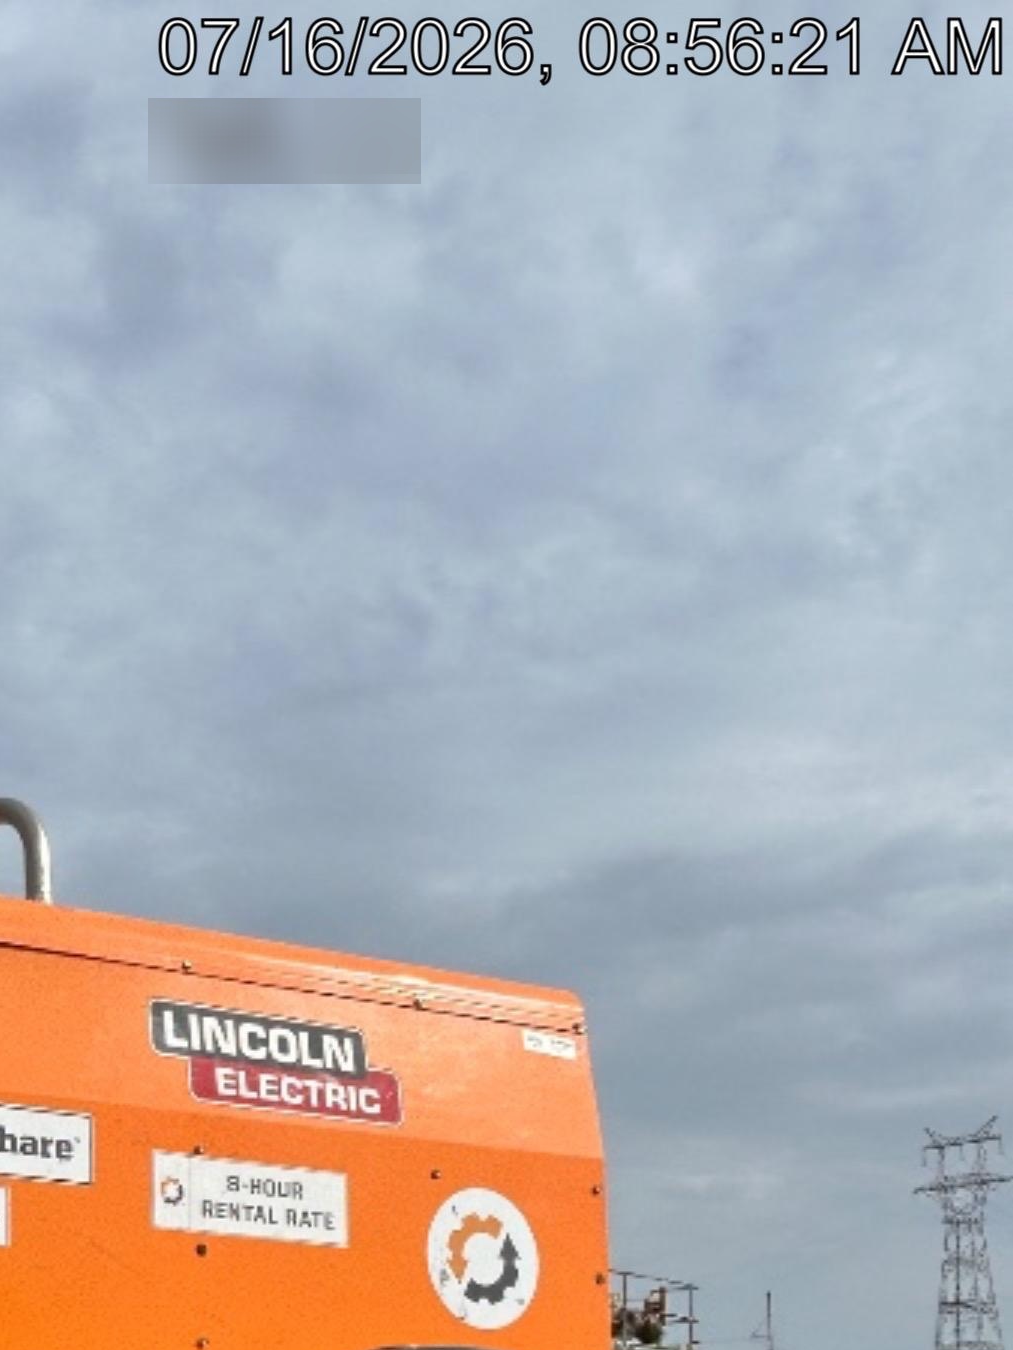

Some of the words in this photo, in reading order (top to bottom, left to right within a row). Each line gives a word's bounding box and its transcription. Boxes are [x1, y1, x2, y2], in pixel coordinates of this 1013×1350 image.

[162, 1010, 357, 1073] LINCOLN
[214, 1067, 382, 1115] ELECTRIC
[227, 1175, 303, 1200] 8-HOUR
[202, 1199, 279, 1225] RENTAL
[285, 1208, 336, 1231] RATE
